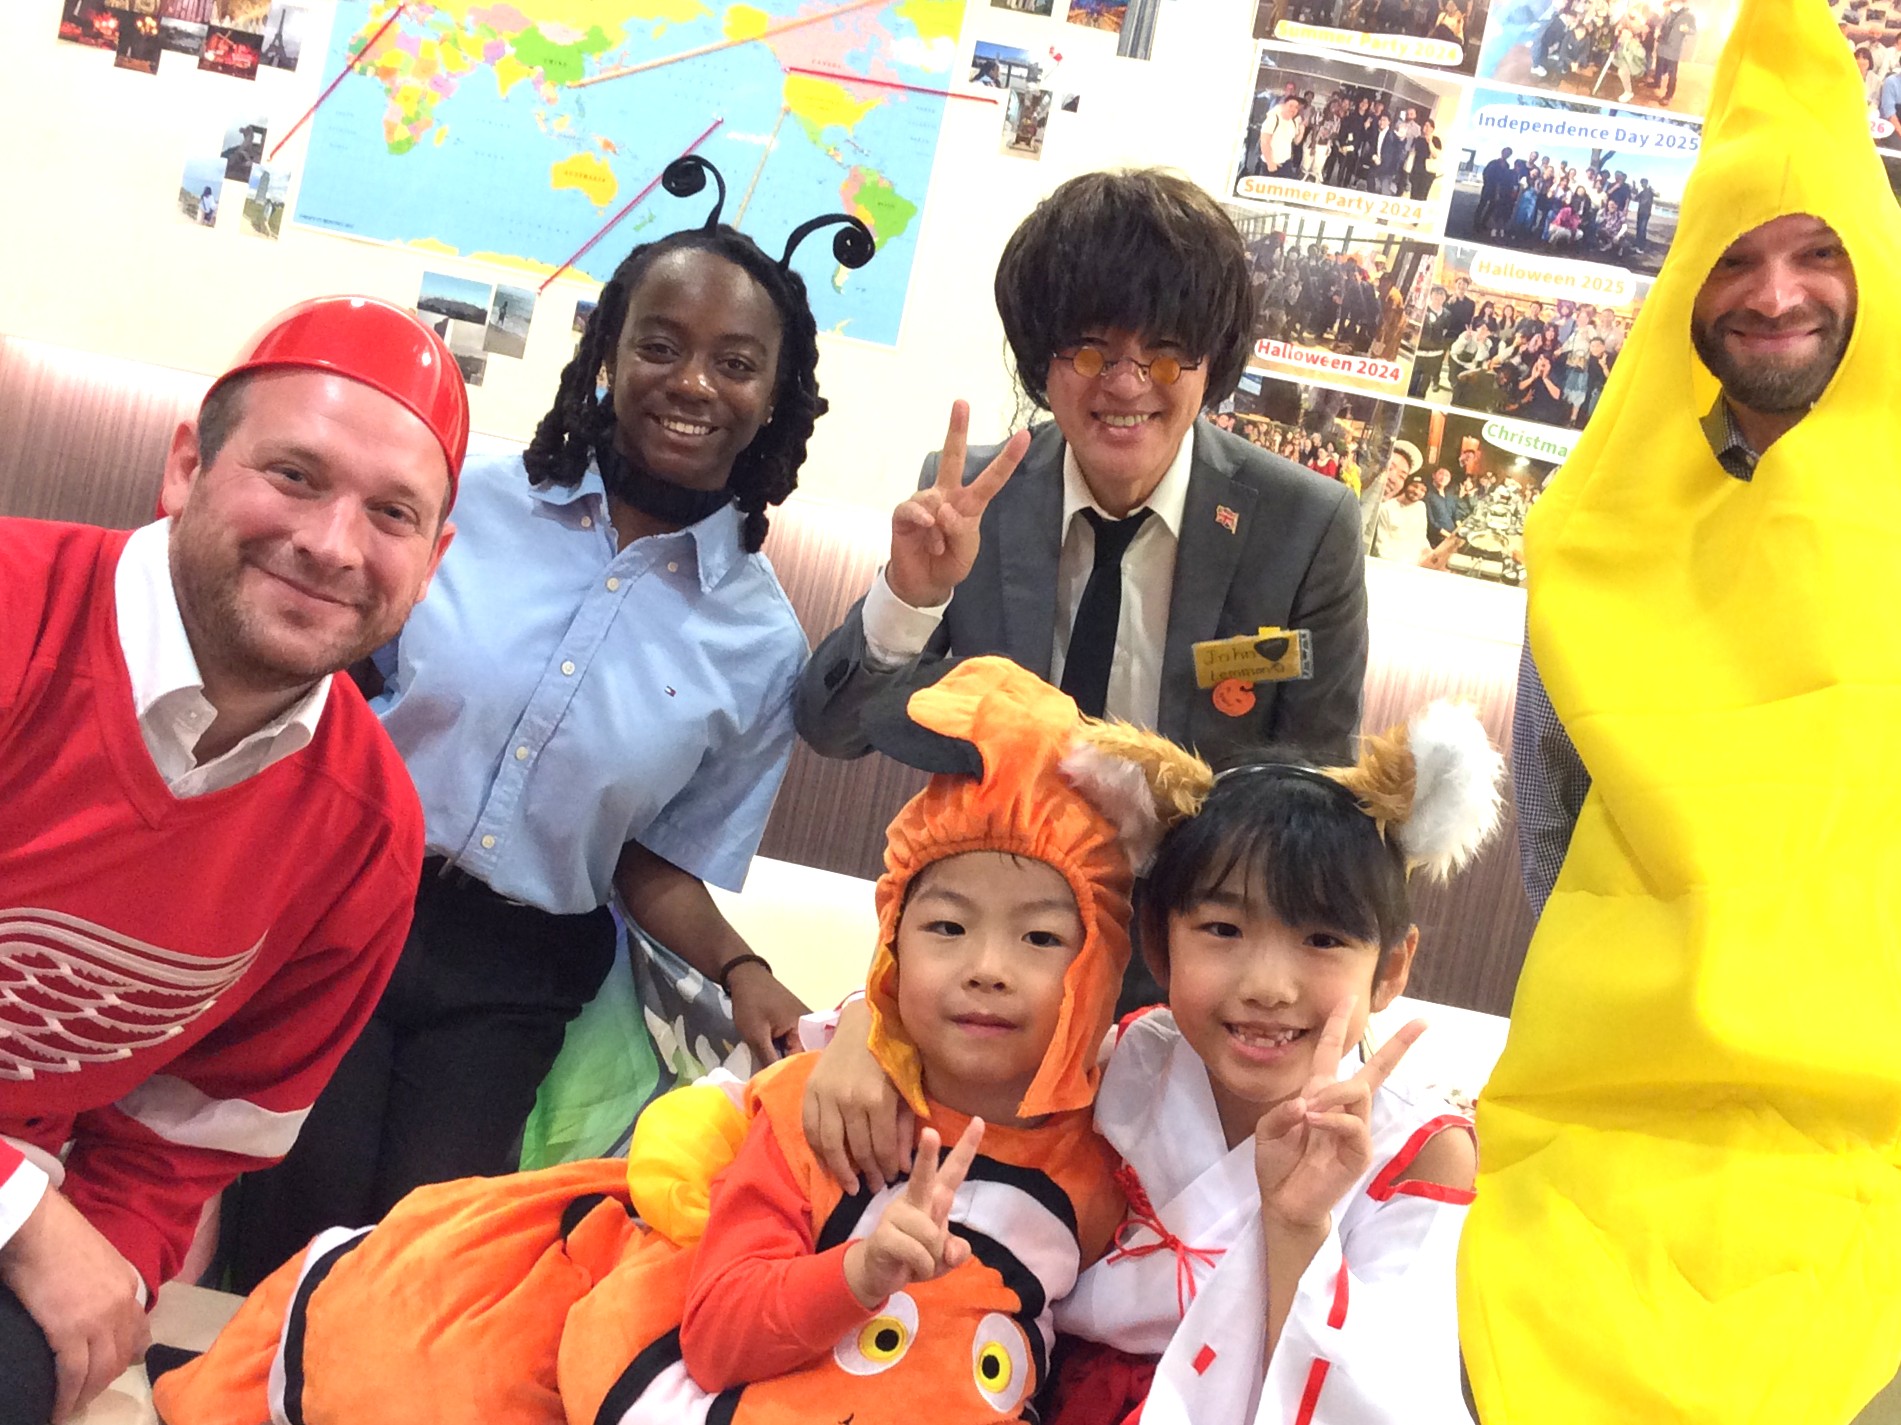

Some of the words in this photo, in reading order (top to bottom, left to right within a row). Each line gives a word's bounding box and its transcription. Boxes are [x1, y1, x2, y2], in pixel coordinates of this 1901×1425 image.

[1278, 20, 1353, 44] Summer
[1359, 32, 1408, 57] Party
[1478, 113, 1609, 140] Independence
[1615, 128, 1649, 147] Day
[1655, 133, 1698, 150] 2025
[1244, 179, 1320, 202] Summer
[1325, 192, 1374, 213] Party
[1380, 201, 1422, 220] 2024
[1478, 260, 1576, 287] Halloween
[1581, 275, 1625, 294] 2025
[1257, 339, 1352, 371] Halloween
[1356, 360, 1400, 381] 2024
[1487, 423, 1568, 458] Christma
